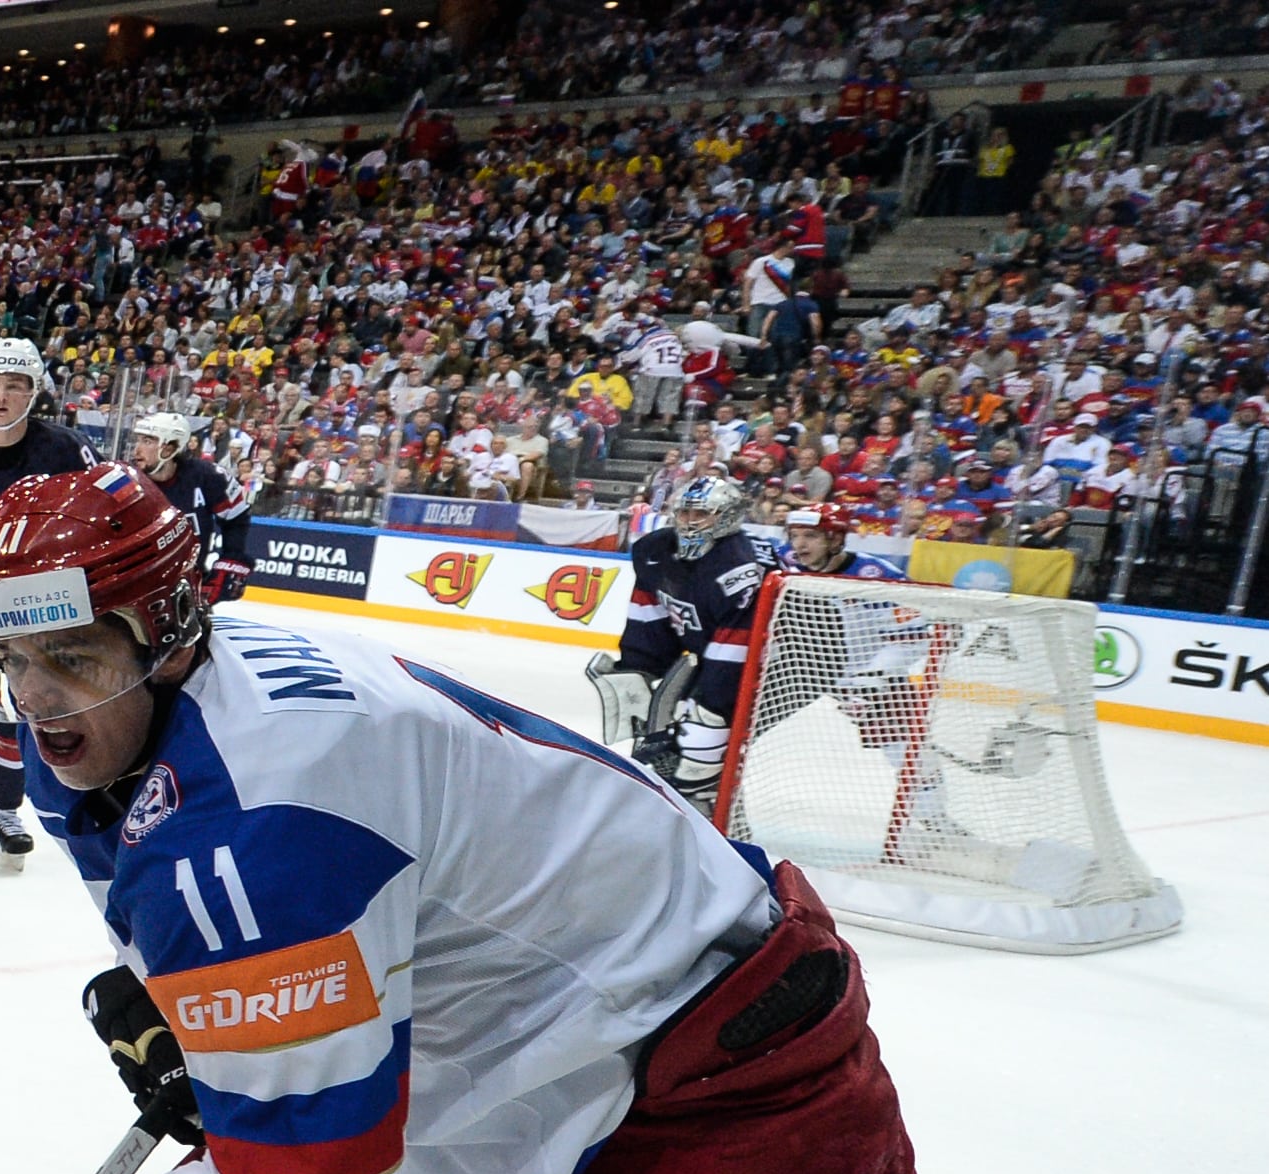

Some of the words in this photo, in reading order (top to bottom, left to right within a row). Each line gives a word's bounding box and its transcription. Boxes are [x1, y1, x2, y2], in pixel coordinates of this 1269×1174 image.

[656, 346, 679, 363] 15
[194, 487, 206, 508] A
[423, 503, 476, 527] ШАРЬЯ
[267, 539, 347, 566] VODKA
[254, 558, 291, 577] ROM
[296, 564, 366, 586] SIBERIA
[13, 593, 41, 607] СЕТЬ
[45, 590, 70, 602] АЗС
[175, 845, 261, 952] 11
[269, 960, 347, 987] ТОПЛИВО
[160, 1066, 186, 1085] CC
